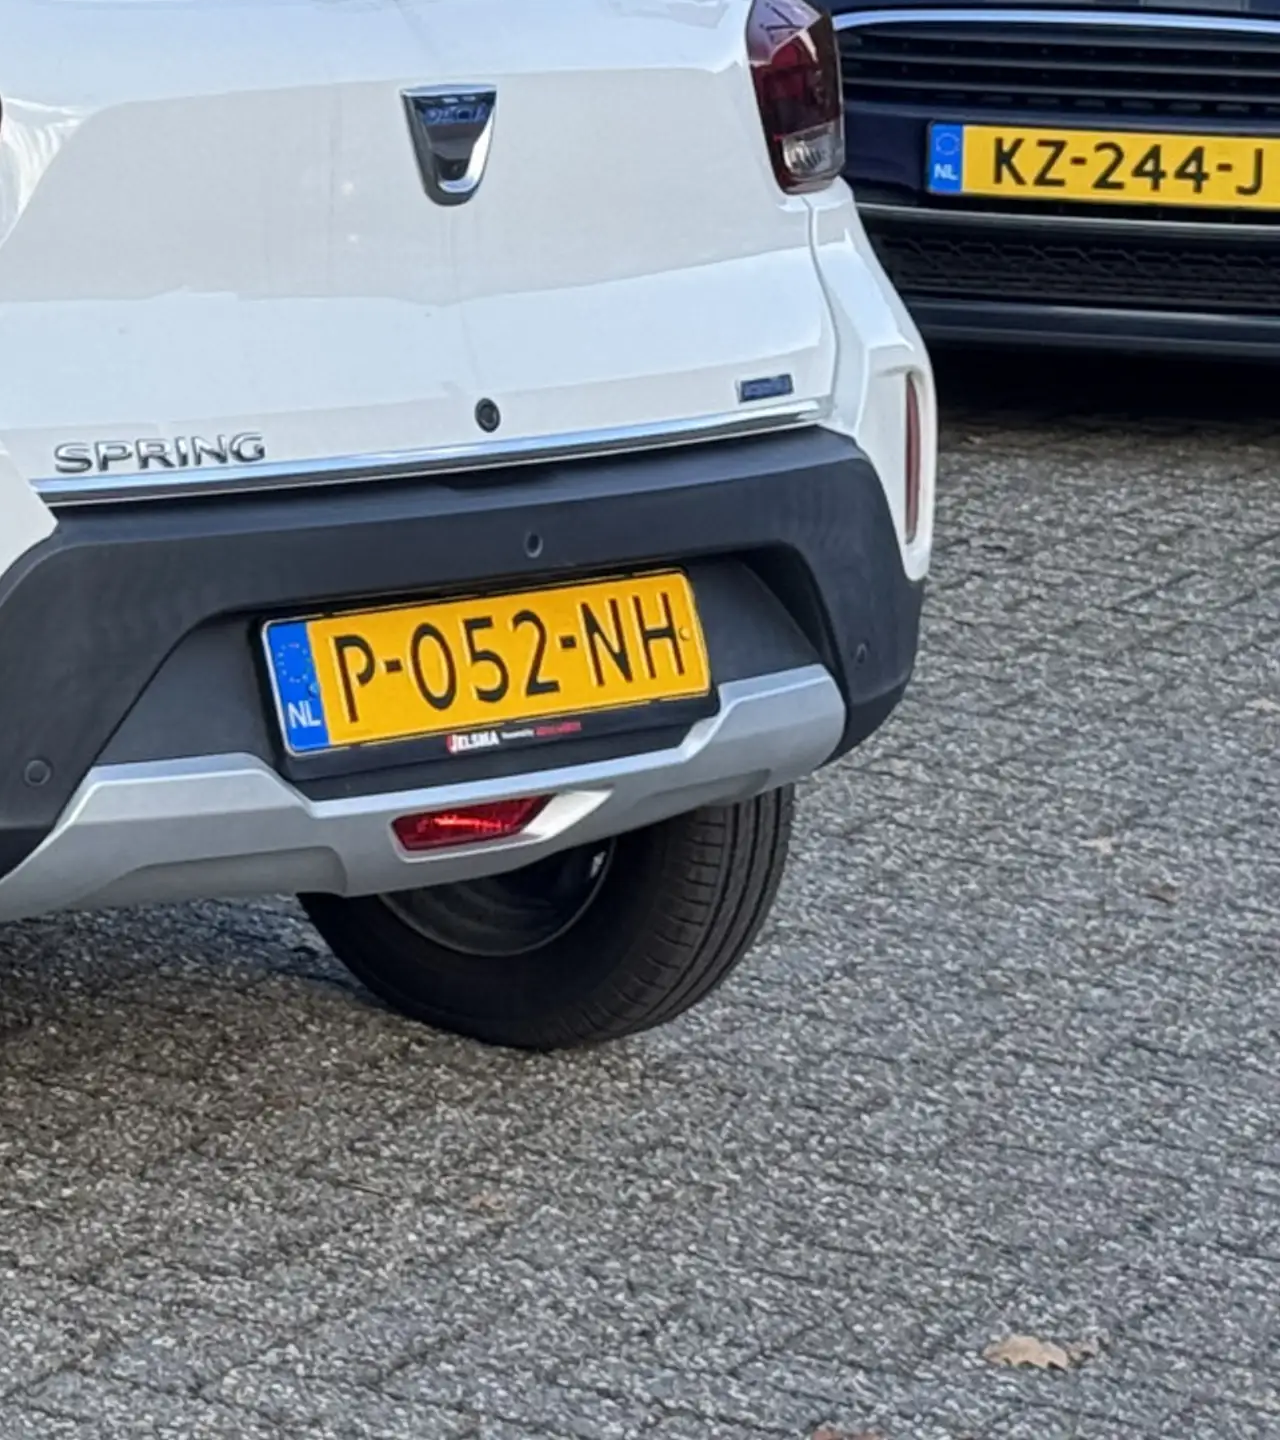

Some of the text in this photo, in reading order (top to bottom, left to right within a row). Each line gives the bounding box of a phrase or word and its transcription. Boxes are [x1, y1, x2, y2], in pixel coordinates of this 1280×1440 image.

[933, 163, 959, 181] NL
[993, 137, 1265, 196] KZ-244-J
[54, 431, 266, 474] SPRING
[330, 591, 686, 724] P-052-NH
[286, 700, 322, 729] NL
